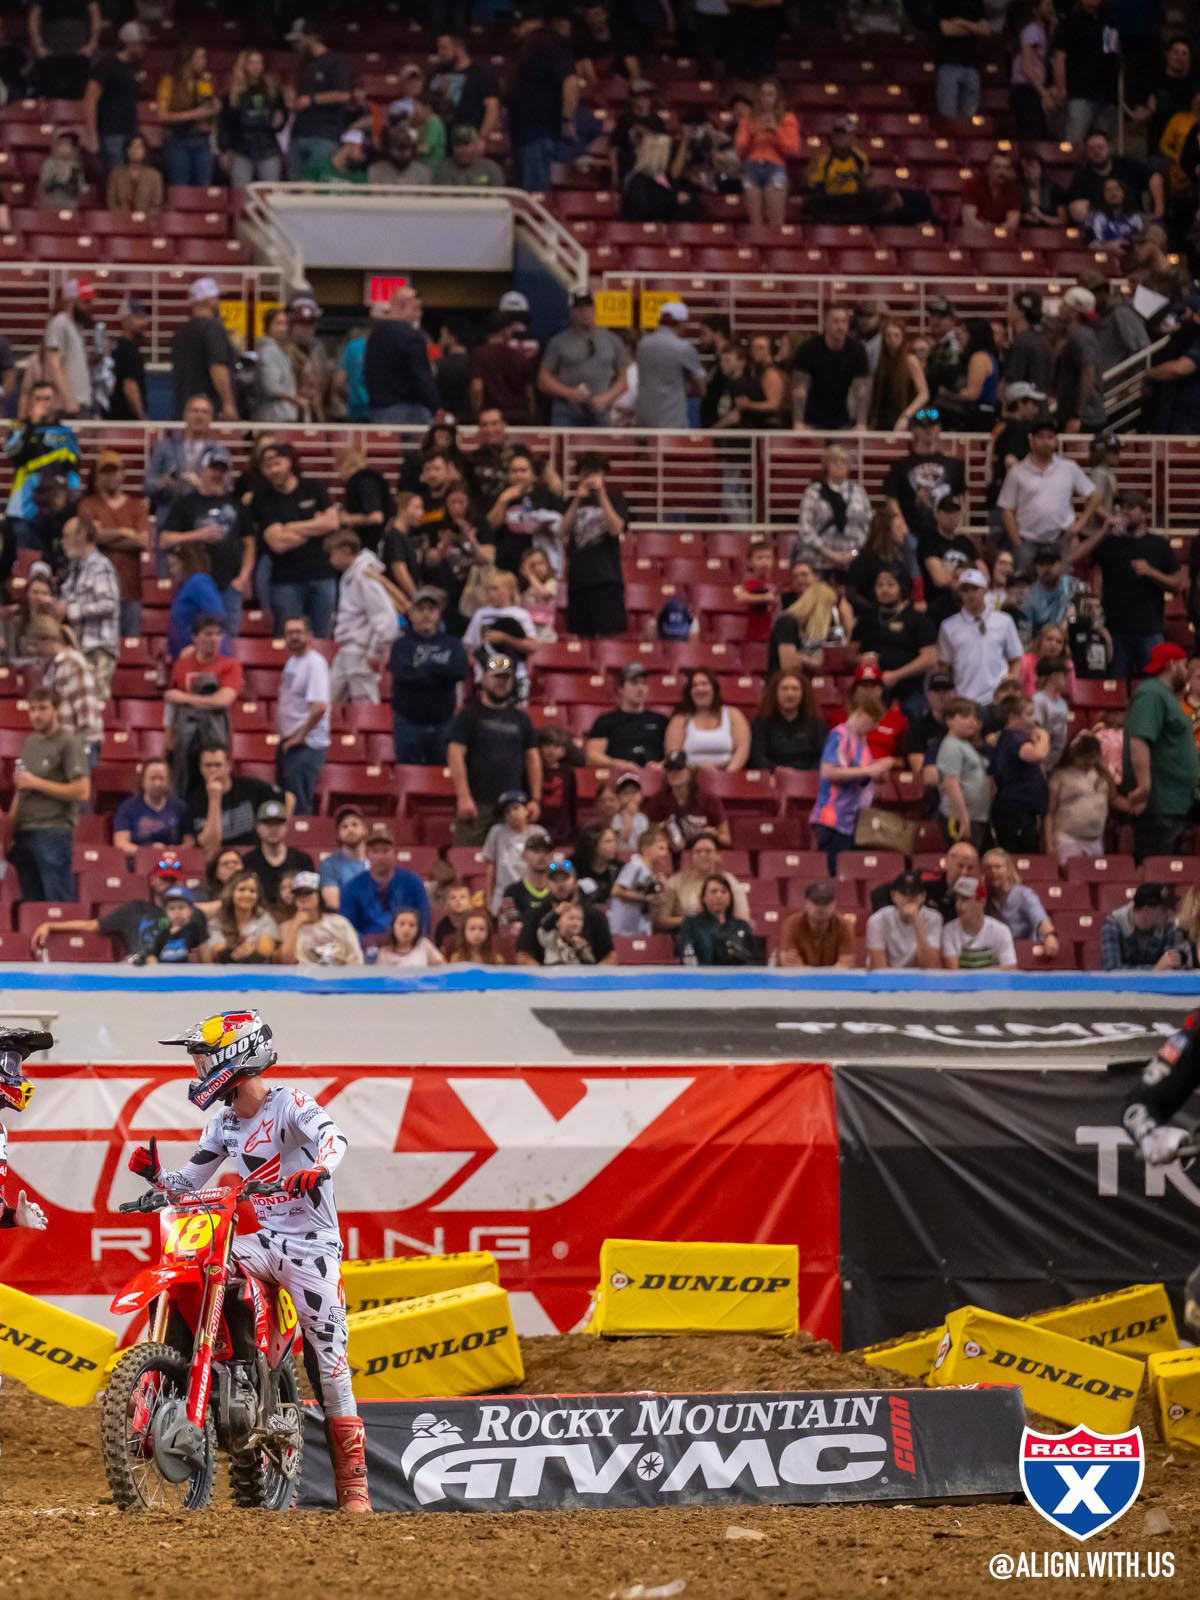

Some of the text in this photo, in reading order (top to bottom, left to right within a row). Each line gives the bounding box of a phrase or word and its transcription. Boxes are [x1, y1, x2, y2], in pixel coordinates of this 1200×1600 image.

[216, 1030, 264, 1063] 100%
[91, 1226, 531, 1261] RING
[165, 1213, 221, 1255] 18
[639, 1273, 790, 1293] DUNLOP
[0, 1322, 98, 1373] NLOP
[364, 1326, 508, 1376] DUNLOP
[1079, 1314, 1167, 1348] NLOP
[989, 1350, 1134, 1402] DUNLOP
[472, 1396, 883, 1442] ROCKY MOUNTAIN
